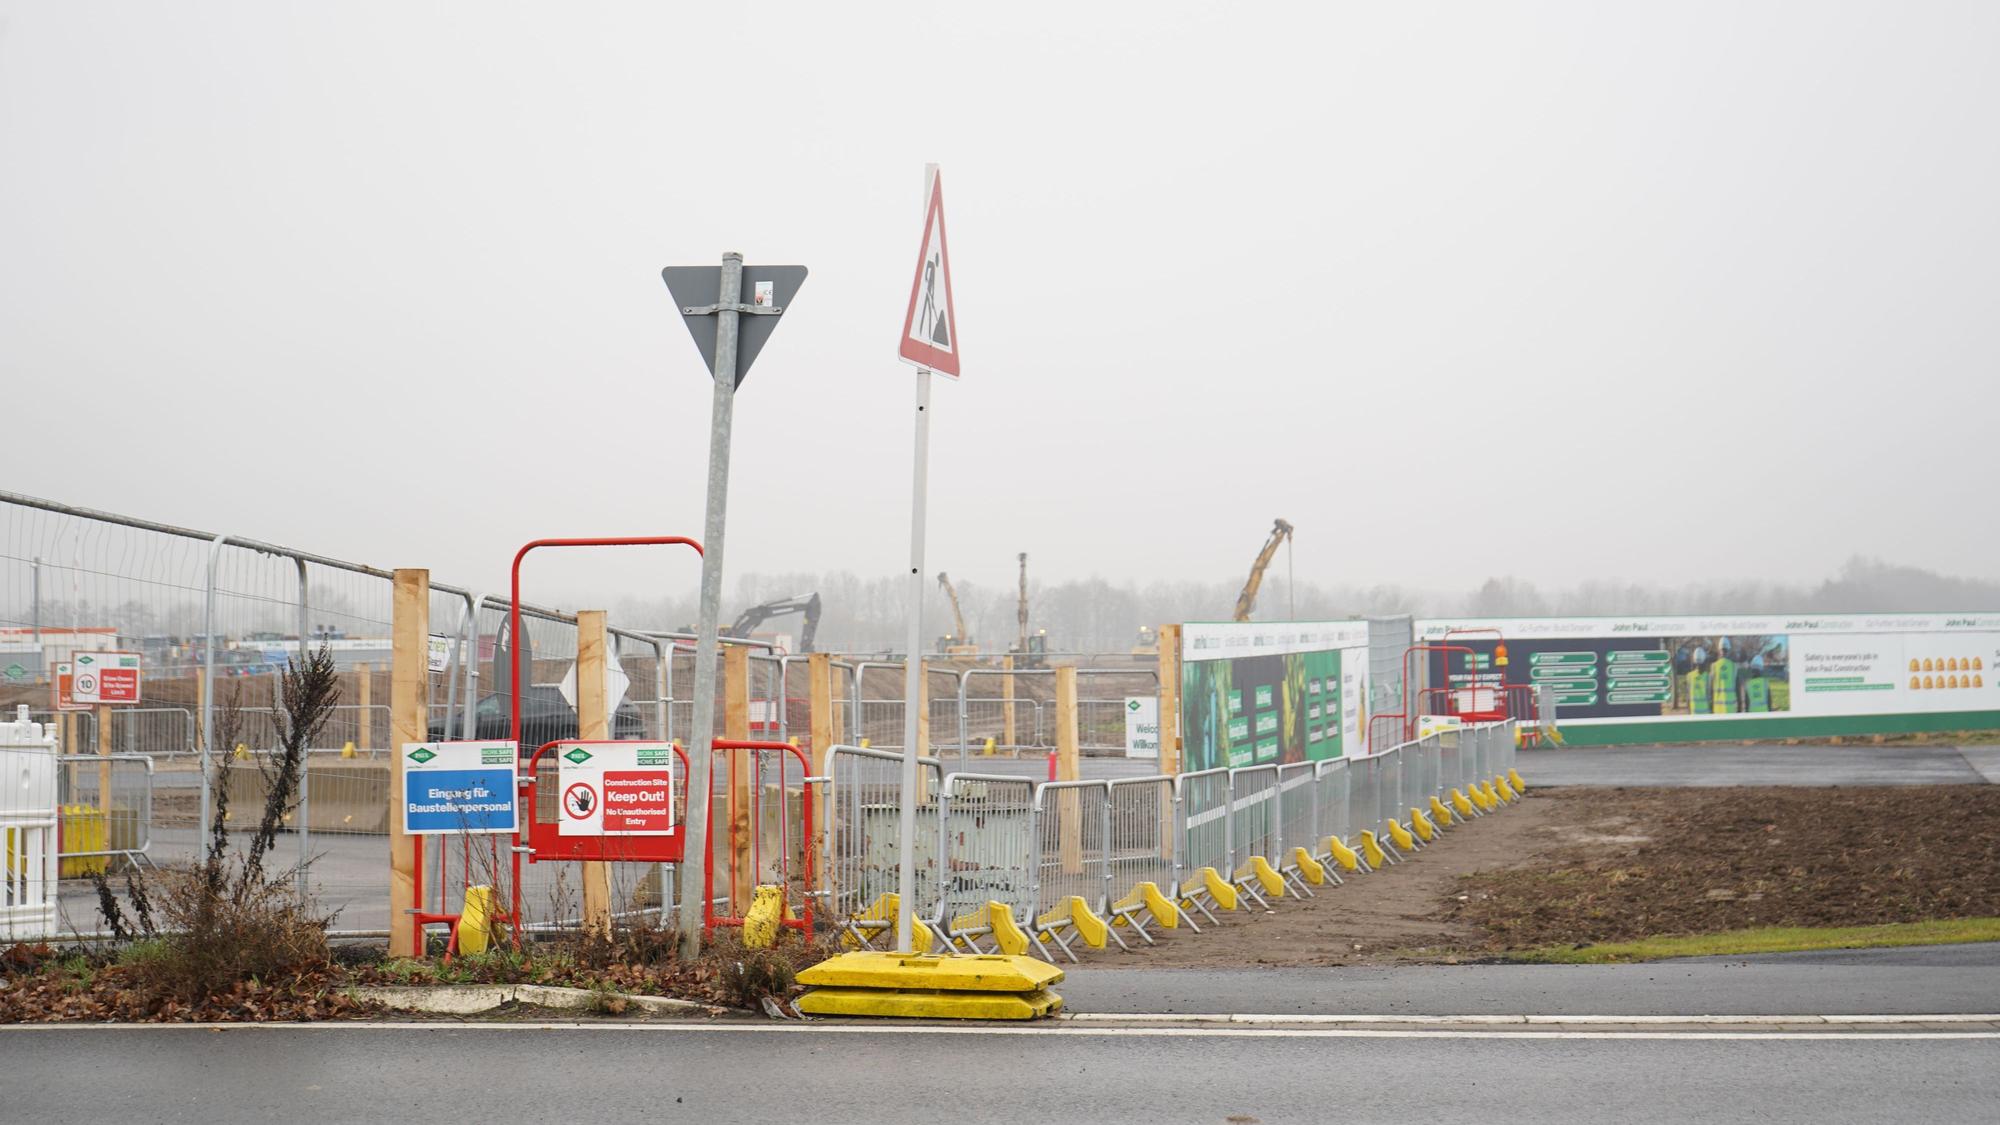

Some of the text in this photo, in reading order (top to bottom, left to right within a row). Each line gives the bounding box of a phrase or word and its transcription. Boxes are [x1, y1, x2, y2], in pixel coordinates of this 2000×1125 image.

[1612, 622, 1632, 632] John
[1633, 622, 1648, 632] Paul
[1785, 620, 1803, 630] John
[1804, 620, 1819, 629] Paul
[80, 679, 93, 689] 10
[654, 749, 669, 757] SAFE
[653, 778, 667, 786] Site
[428, 787, 490, 800] Eingang für
[608, 790, 665, 804] Keep Out!
[408, 801, 512, 814] Baustellenpersonal
[606, 808, 667, 816] No Unauthorised
[626, 818, 646, 827] Entry
